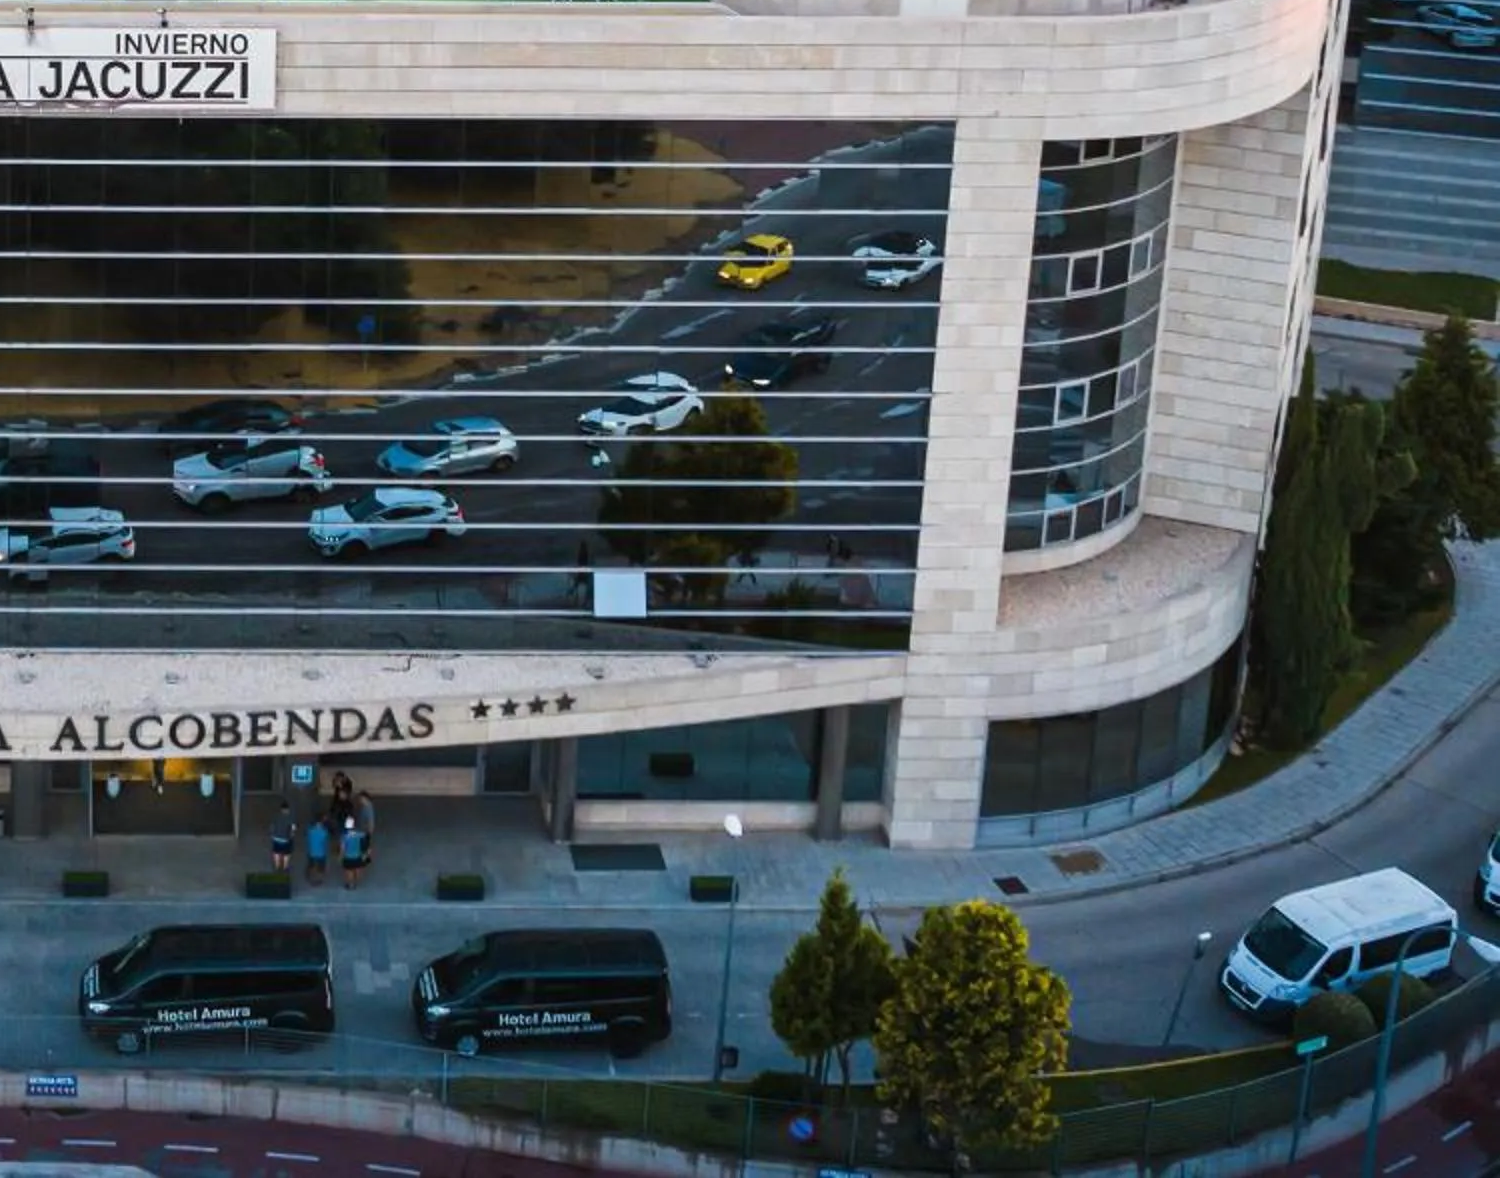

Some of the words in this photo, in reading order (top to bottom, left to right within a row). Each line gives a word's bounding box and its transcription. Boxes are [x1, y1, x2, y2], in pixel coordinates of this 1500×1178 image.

[115, 33, 248, 55] INVIERNO
[38, 60, 249, 100] JACUZZI
[49, 702, 435, 752] ALCOBENDAS
[158, 1007, 198, 1022] Hotel
[201, 1006, 251, 1020] Amura
[499, 1012, 539, 1027] Hotel
[542, 1010, 591, 1025] Amura
